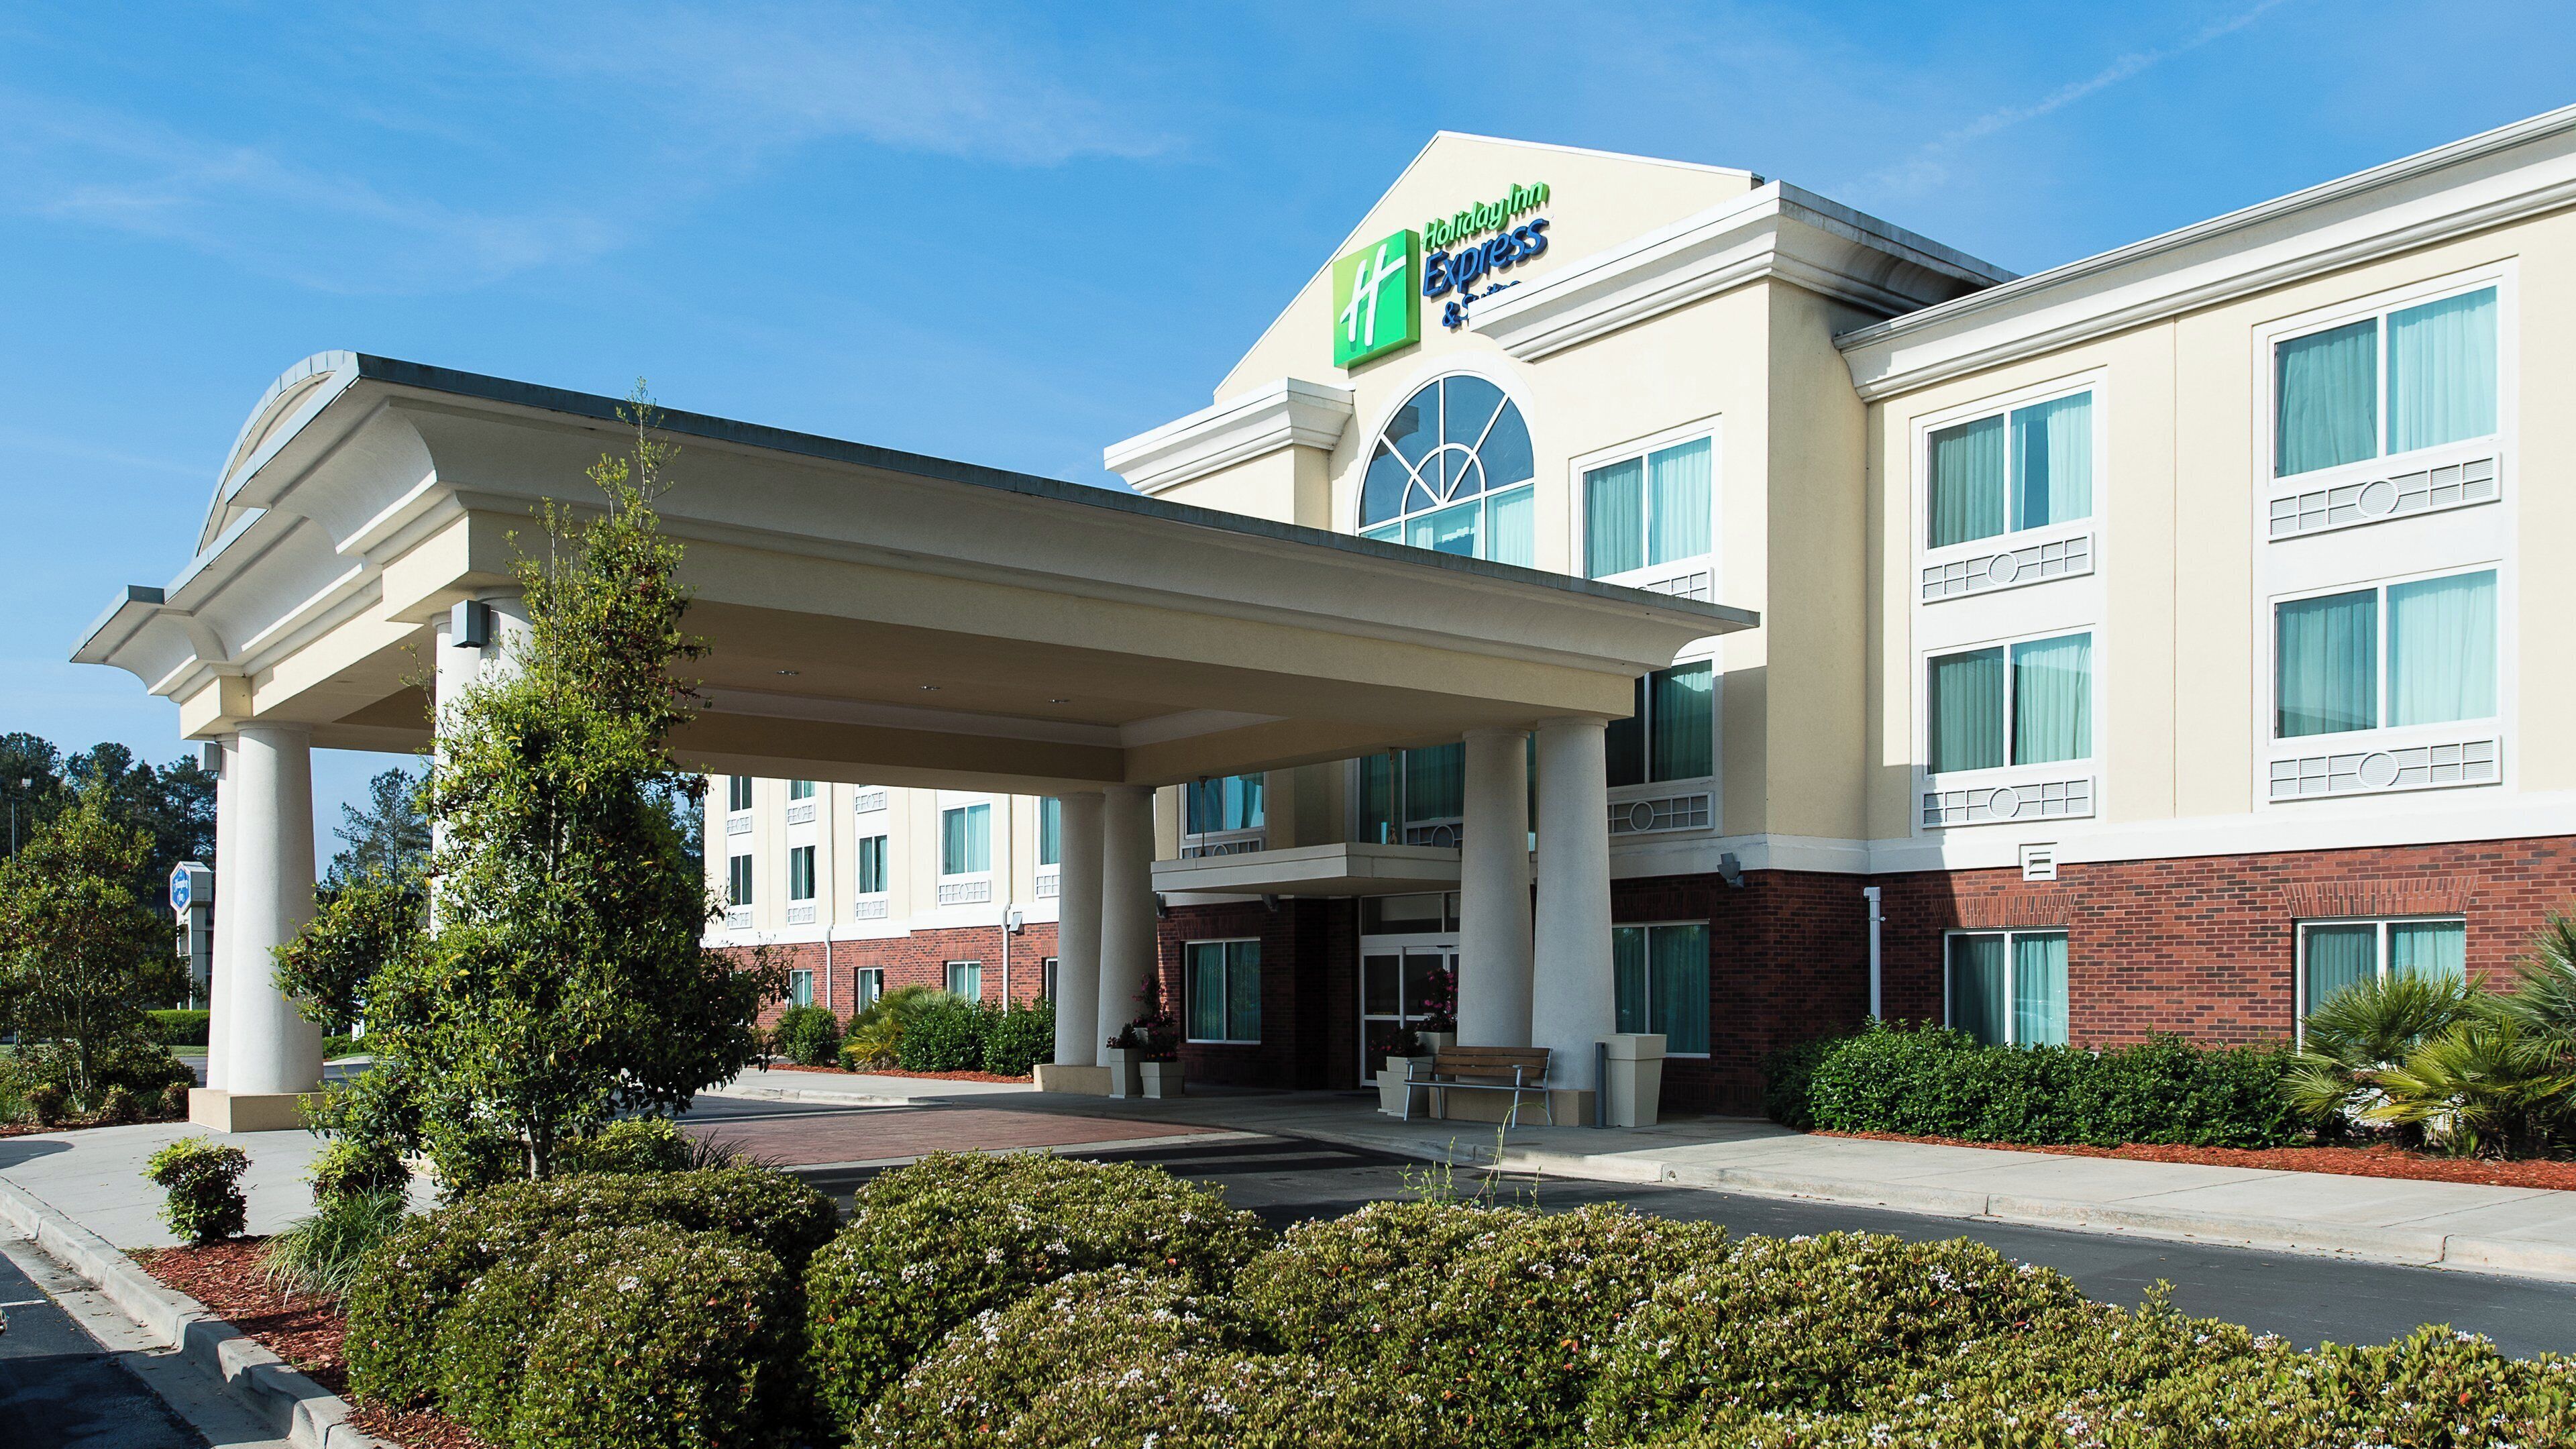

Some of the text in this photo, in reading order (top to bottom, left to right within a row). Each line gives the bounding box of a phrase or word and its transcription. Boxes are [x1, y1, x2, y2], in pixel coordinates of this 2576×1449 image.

[1423, 182, 1550, 253] Holiday Inn
[1423, 219, 1550, 297] Express
[1442, 301, 1460, 329] &
